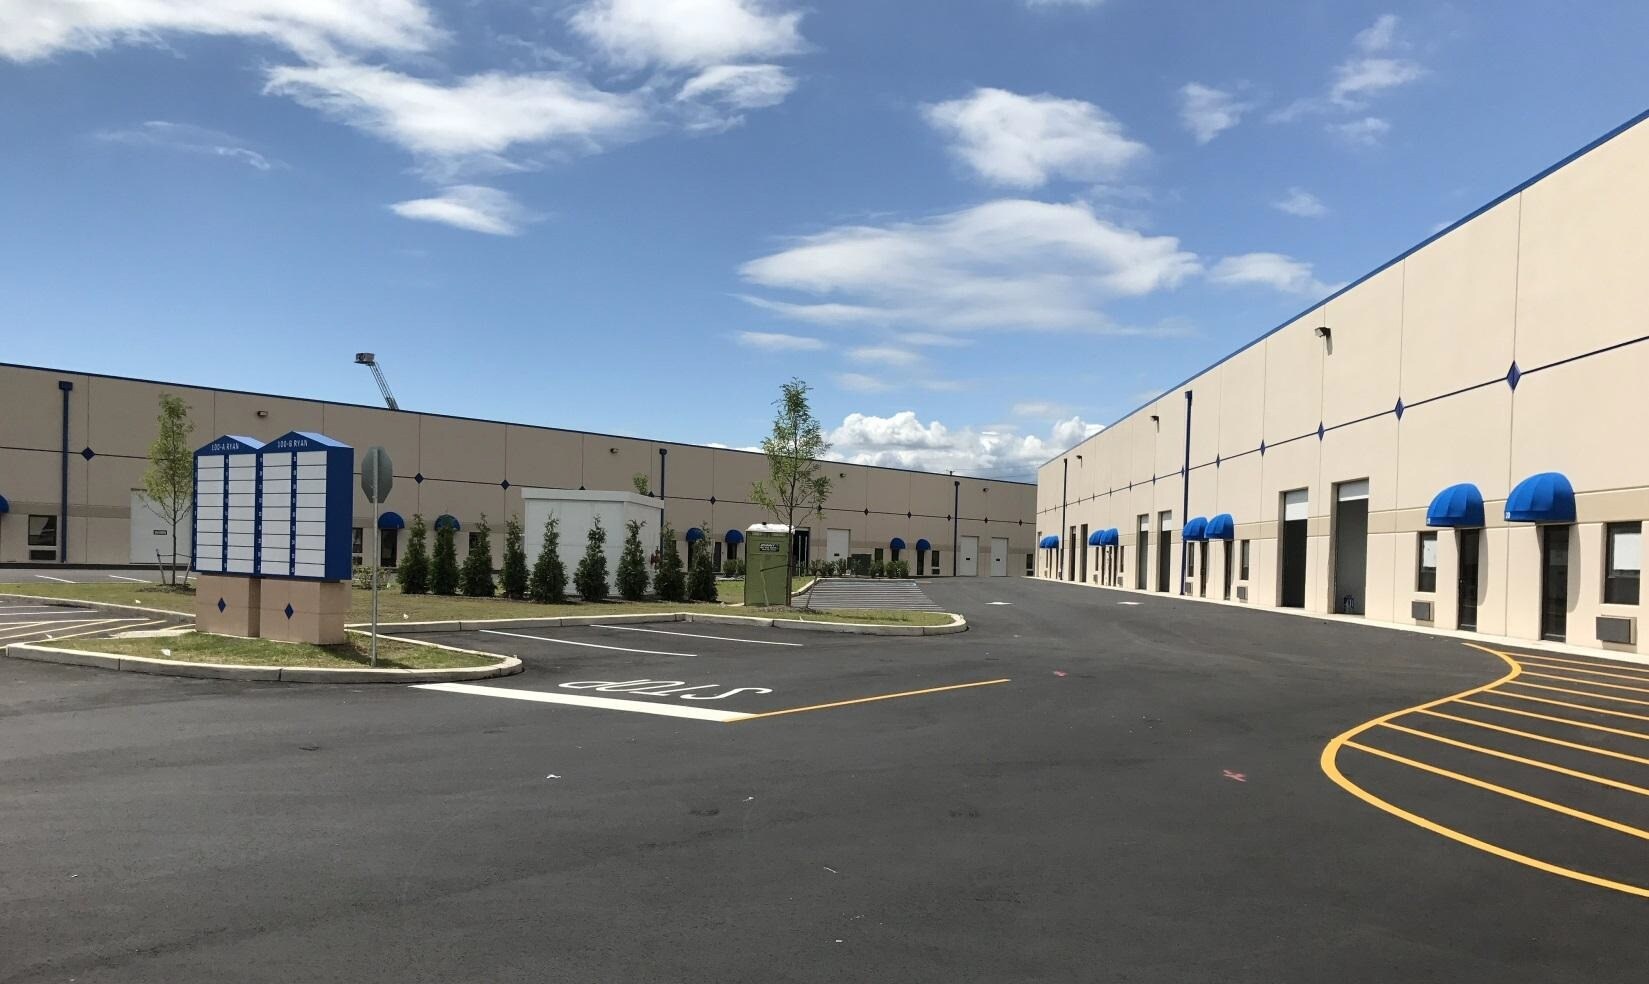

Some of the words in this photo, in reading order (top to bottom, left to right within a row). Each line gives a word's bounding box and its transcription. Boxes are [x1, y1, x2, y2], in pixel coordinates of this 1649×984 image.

[211, 443, 225, 451] 100-A
[226, 442, 240, 450] RYAN
[294, 439, 308, 447] RYAN
[558, 679, 773, 700] STOP
